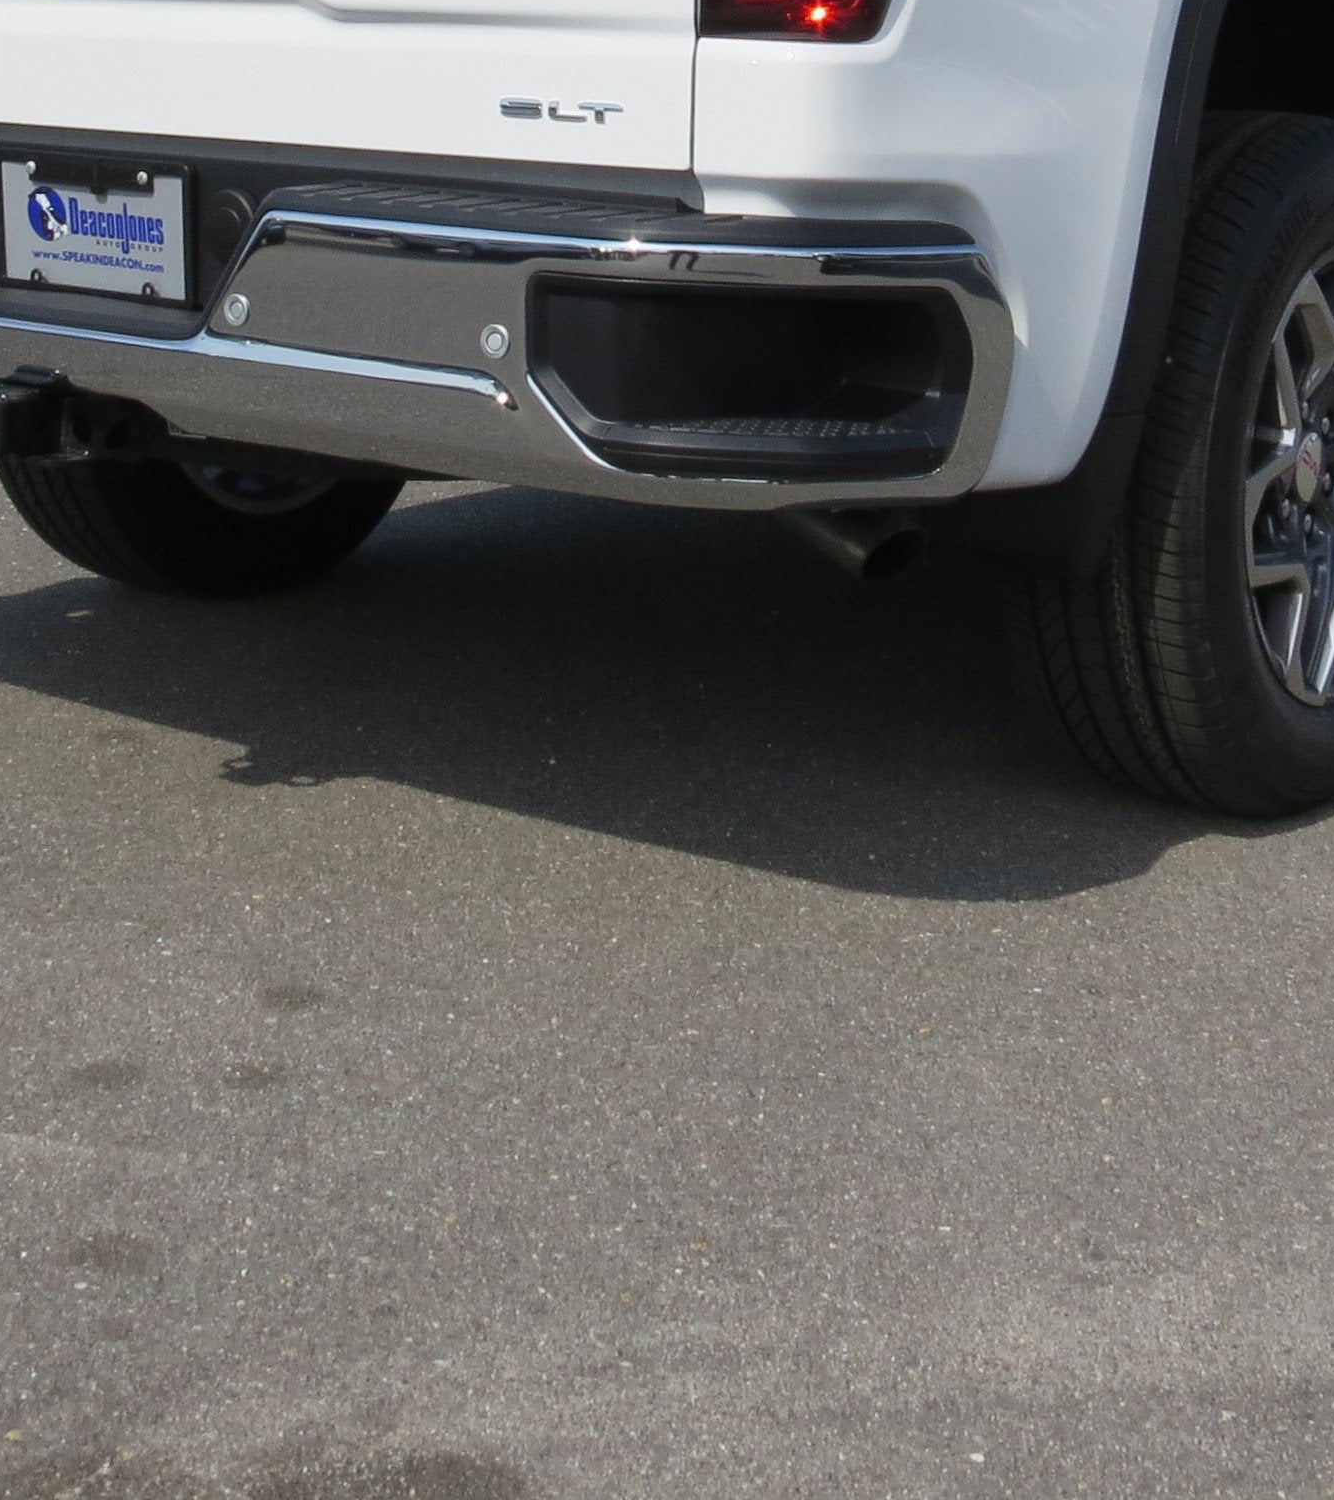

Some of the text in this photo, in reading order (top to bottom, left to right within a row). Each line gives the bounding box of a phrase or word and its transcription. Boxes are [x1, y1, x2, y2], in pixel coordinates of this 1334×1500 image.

[499, 97, 624, 125] SLT
[96, 240, 163, 252] AUTO GROUP
